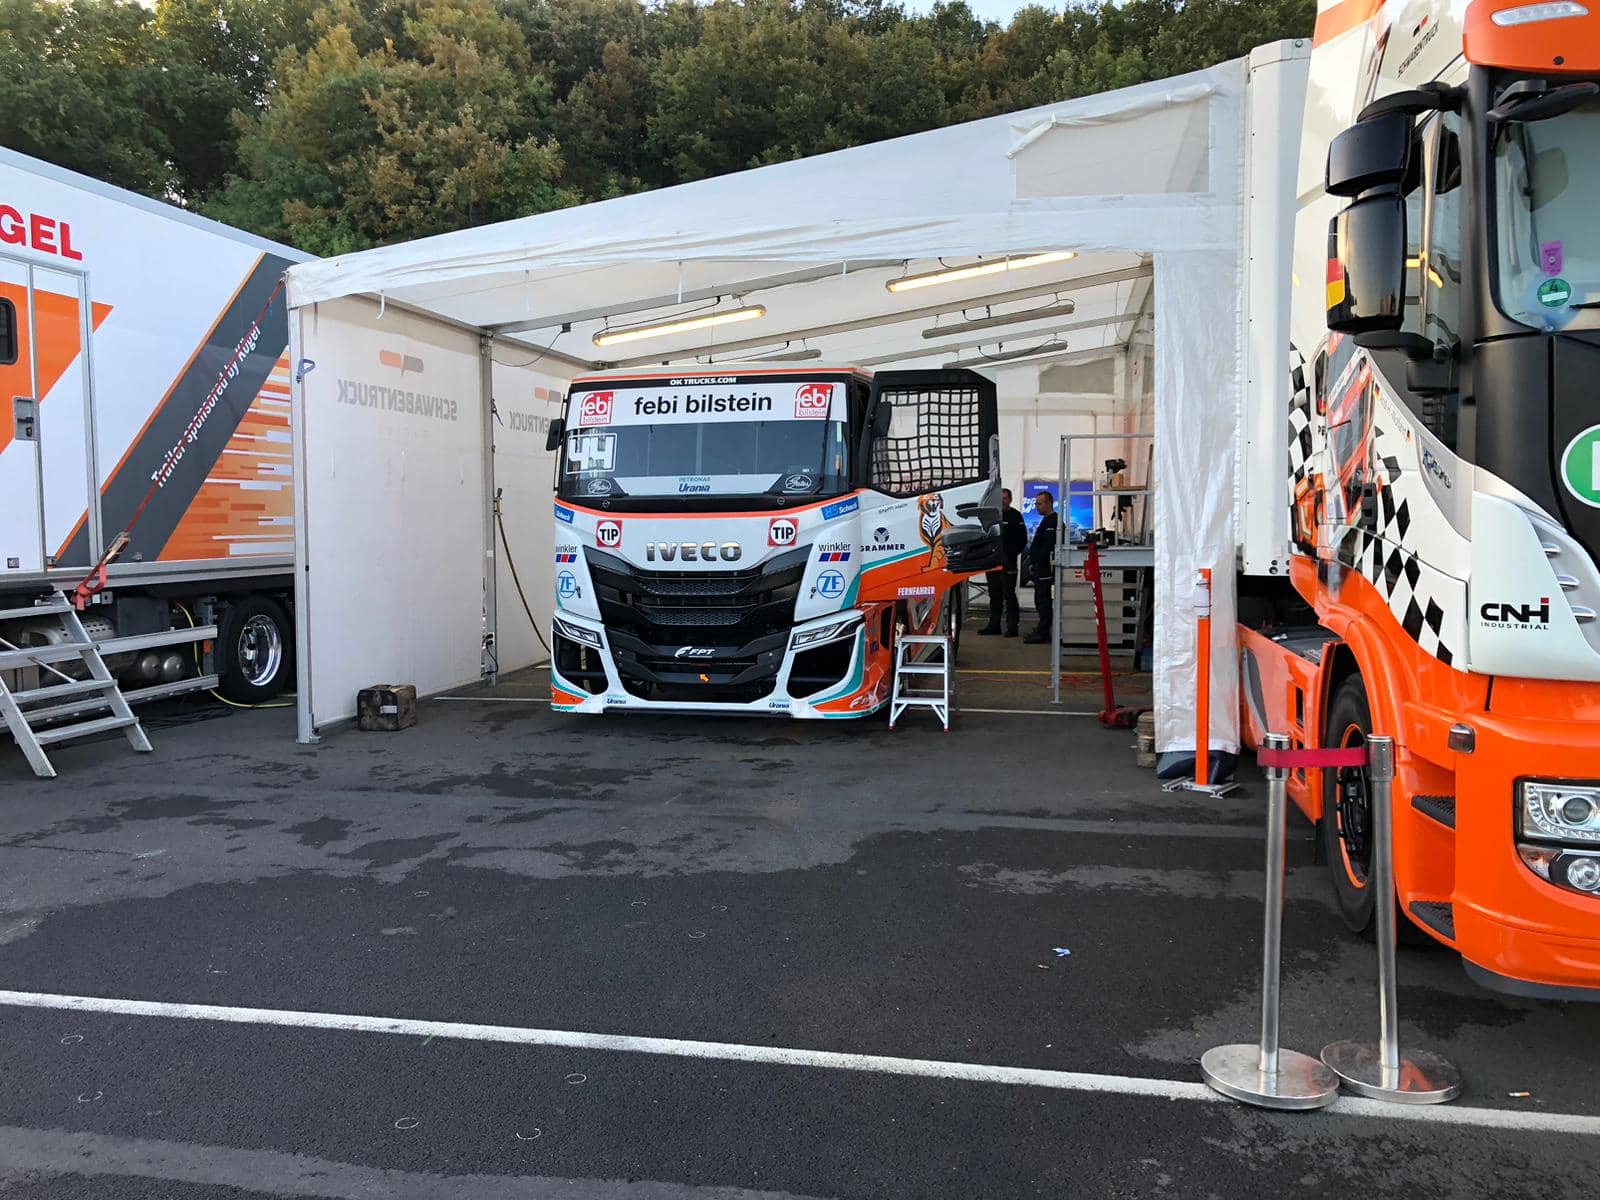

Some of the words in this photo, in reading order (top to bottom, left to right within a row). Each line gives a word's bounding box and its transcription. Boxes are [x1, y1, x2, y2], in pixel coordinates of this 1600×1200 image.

[0, 204, 83, 261] GEL
[634, 395, 678, 415] febi
[686, 392, 772, 414] bilstein
[151, 440, 186, 487] Trailer
[184, 372, 229, 443] sponsored
[223, 360, 240, 379] by
[569, 436, 614, 470] 44
[679, 483, 711, 492] Urania
[600, 528, 619, 541] TIP
[773, 526, 794, 540] TIP
[647, 542, 742, 562] IVECO
[818, 542, 851, 552] winkler
[860, 543, 906, 553] GRAMMER
[560, 576, 574, 593] ZF
[821, 575, 840, 593] ZF
[1480, 602, 1549, 624] CNH
[1480, 621, 1549, 631] INDUSTRIAL
[689, 648, 715, 656] FPT
